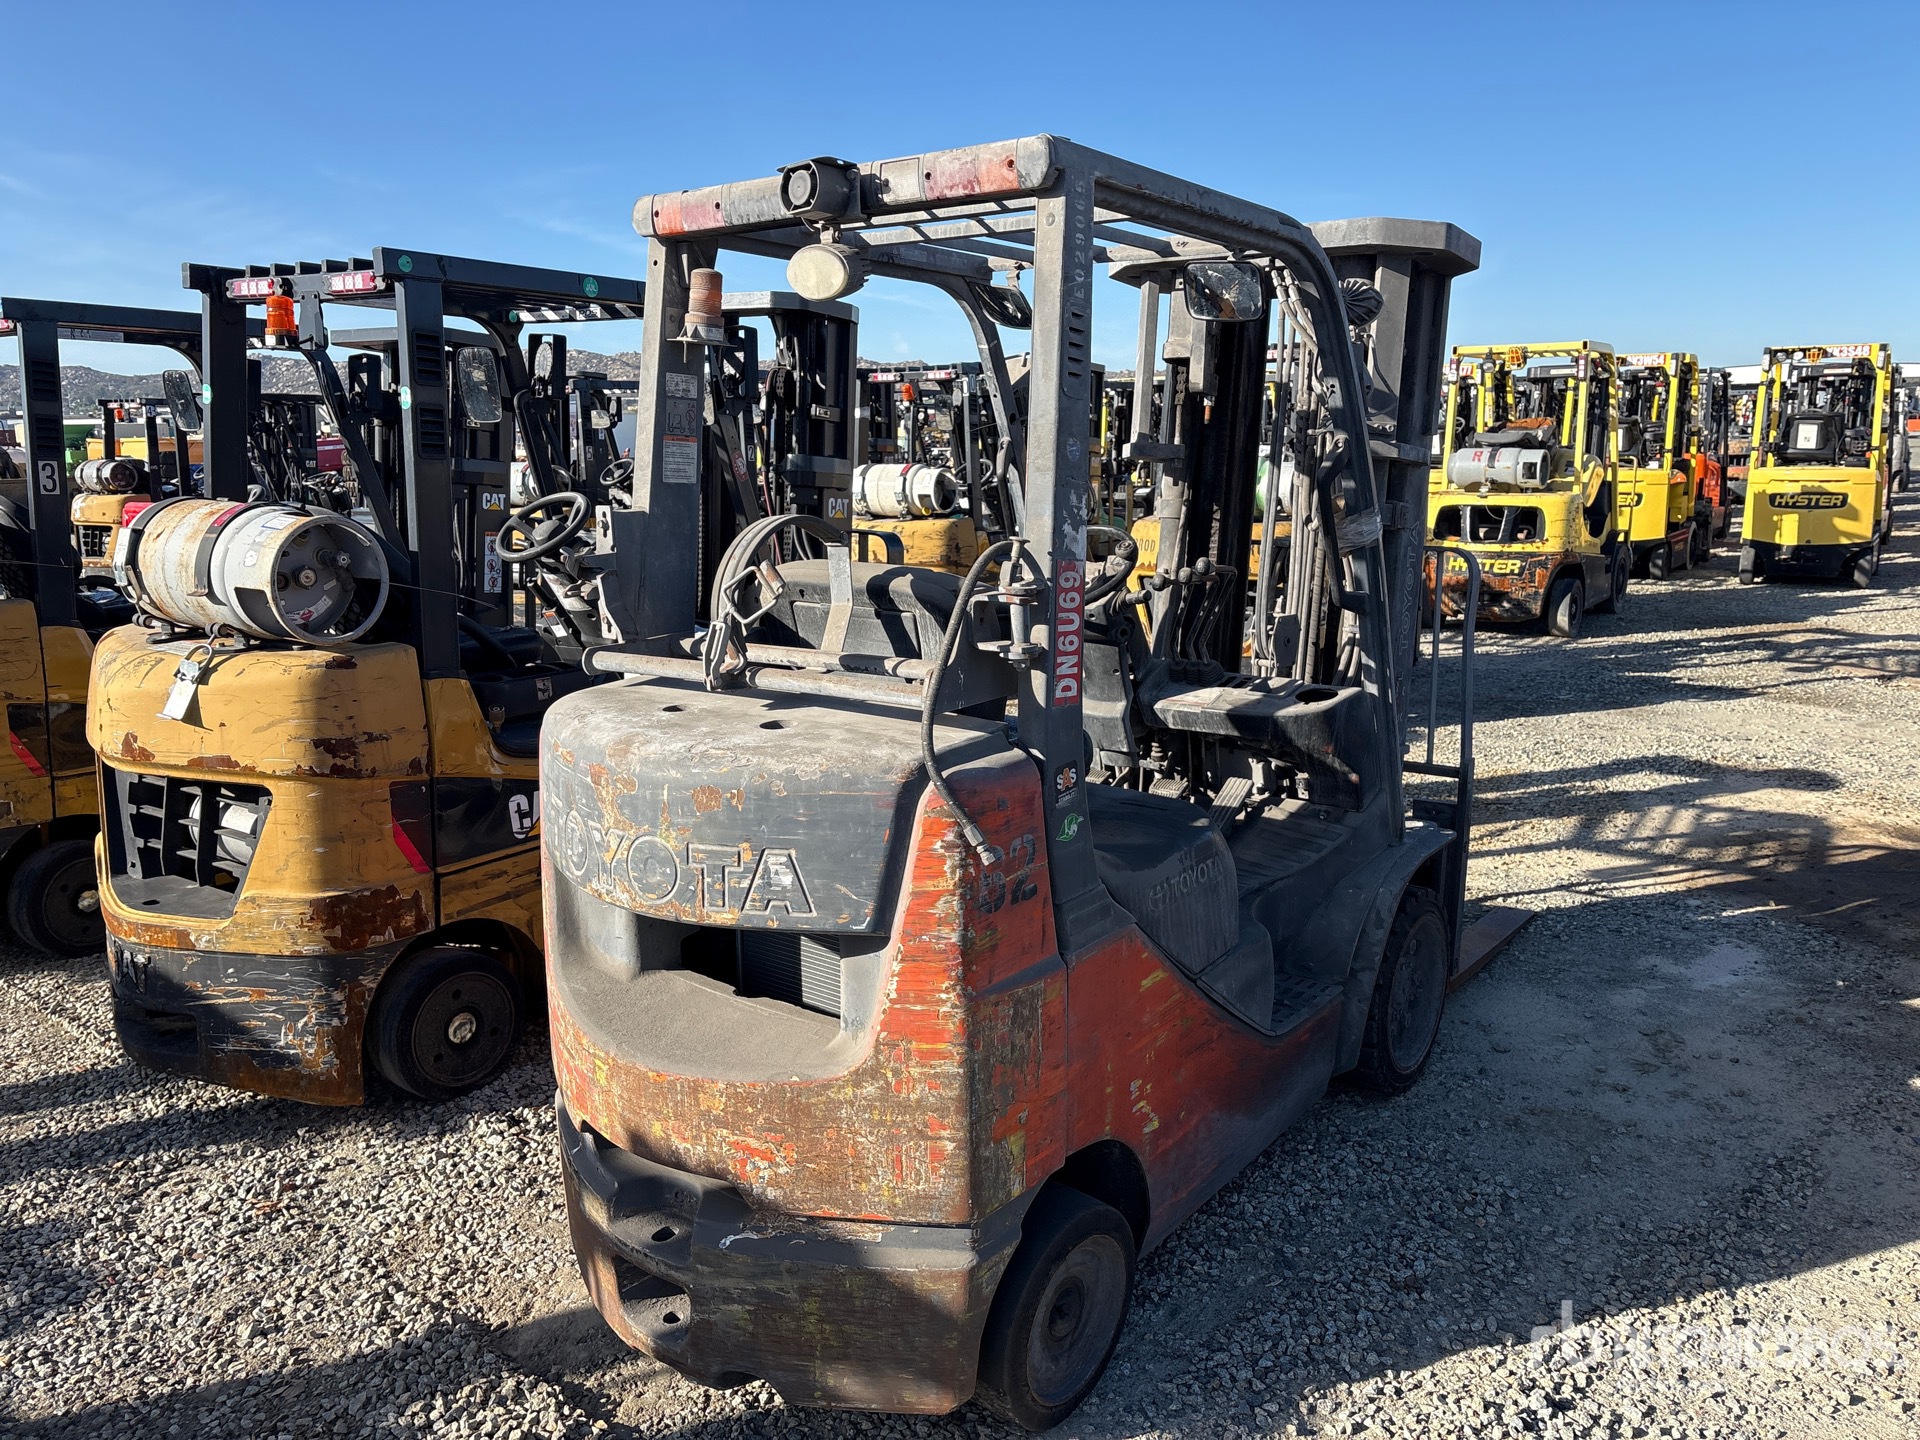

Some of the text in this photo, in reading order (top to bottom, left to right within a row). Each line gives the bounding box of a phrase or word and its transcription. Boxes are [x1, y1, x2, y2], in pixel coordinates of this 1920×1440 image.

[748, 446, 754, 461] 2
[305, 460, 317, 468] CAT
[41, 463, 57, 492] 3
[482, 492, 506, 511] CAT
[828, 497, 849, 519] CAT
[1774, 494, 1843, 506] HYSTER
[1448, 556, 1521, 574] HYTER
[1055, 570, 1081, 698] DN6U69
[1056, 767, 1077, 792] SAS
